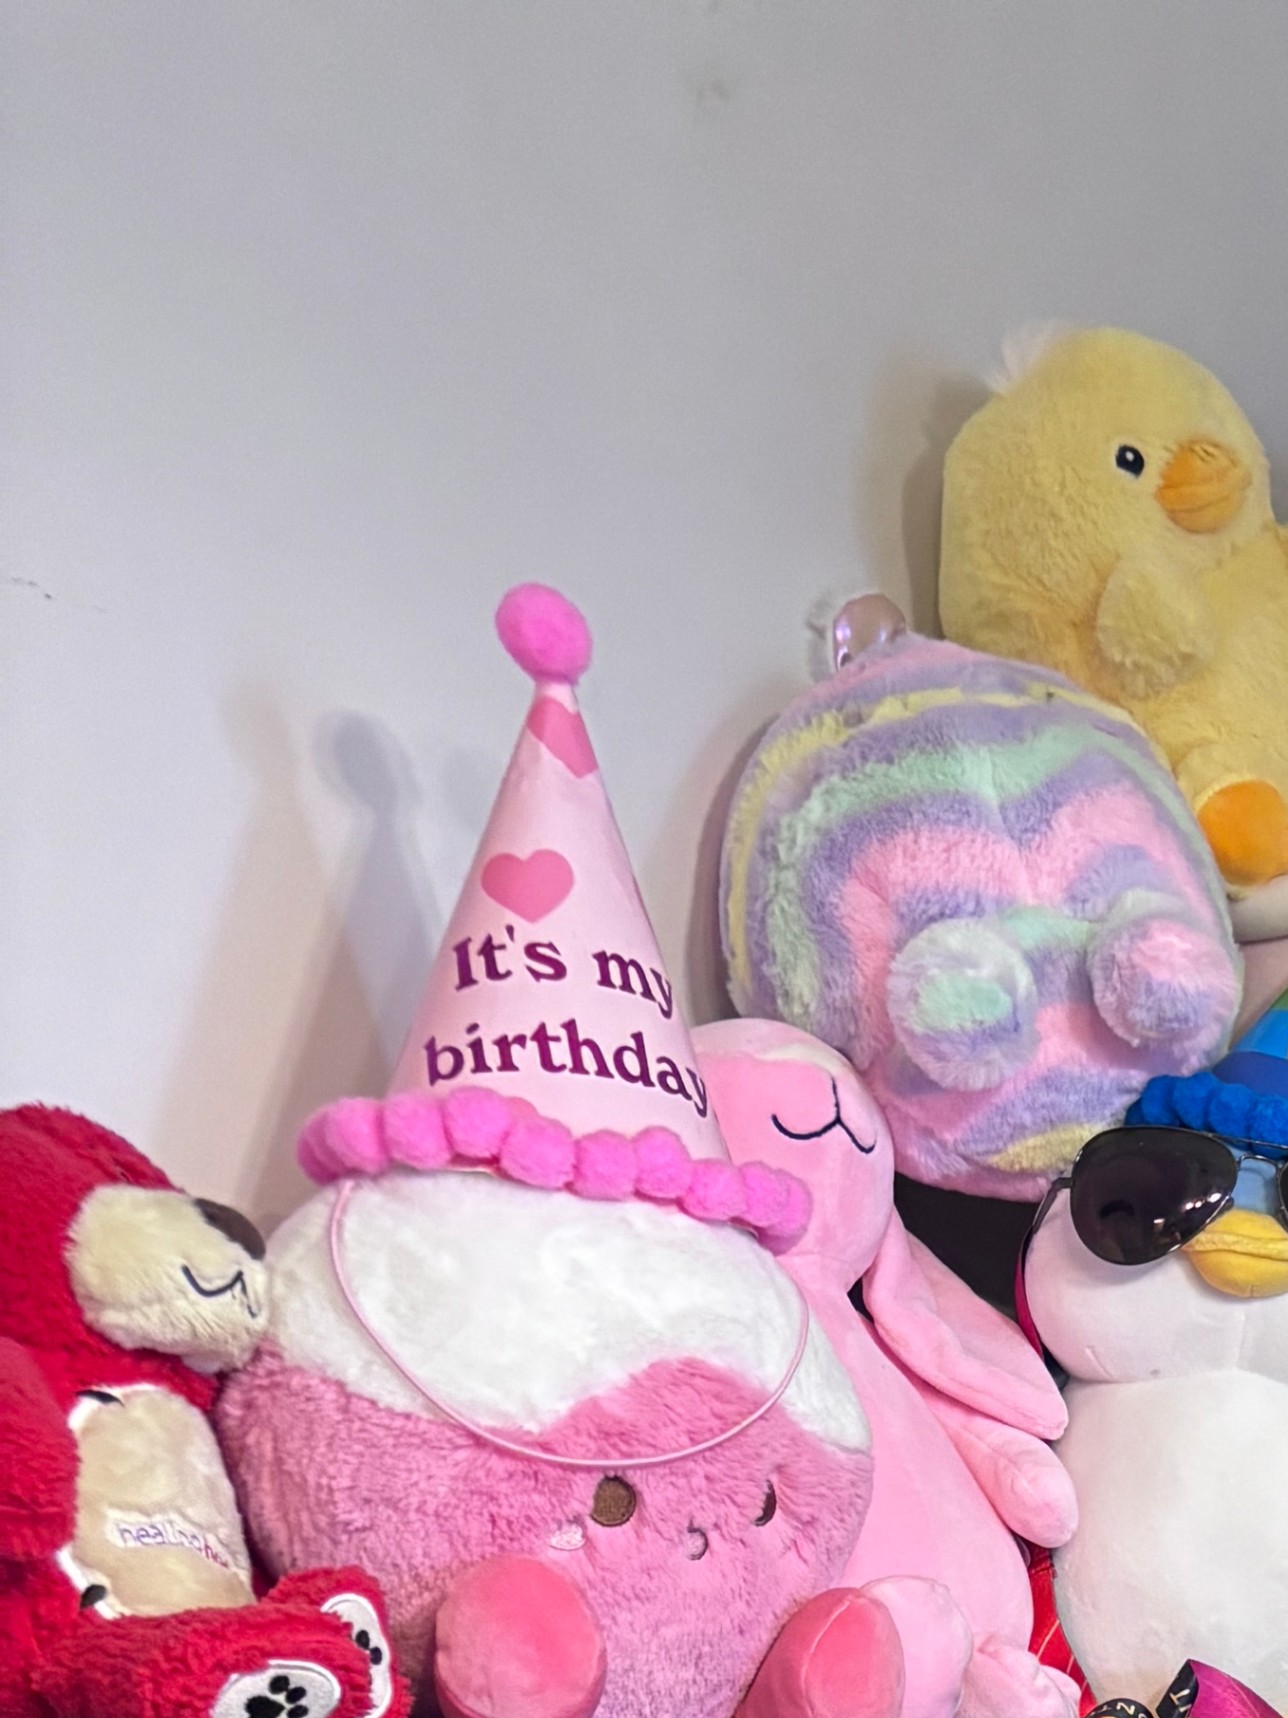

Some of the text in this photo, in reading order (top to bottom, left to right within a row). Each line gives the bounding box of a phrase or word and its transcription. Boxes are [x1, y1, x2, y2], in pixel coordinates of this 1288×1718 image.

[451, 924, 673, 1020] It's my
[423, 1017, 708, 1119] birthday
